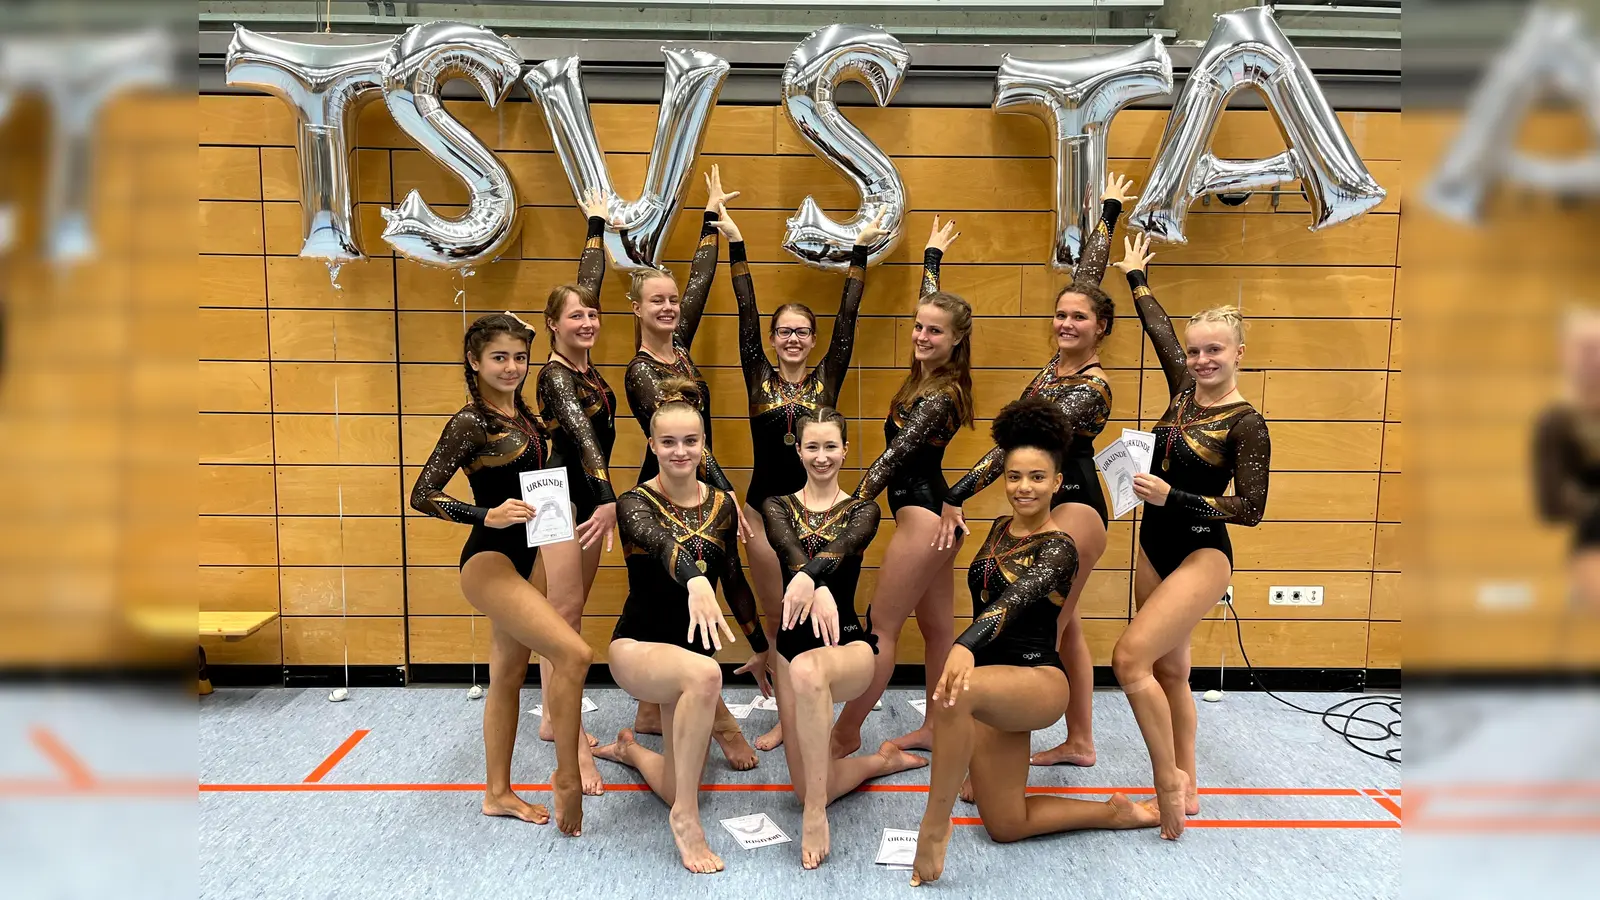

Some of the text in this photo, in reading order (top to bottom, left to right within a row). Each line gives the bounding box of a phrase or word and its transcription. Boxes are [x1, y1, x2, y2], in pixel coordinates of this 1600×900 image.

[225, 5, 1387, 271] TSV STA
[1102, 450, 1127, 471] URKUNDE
[526, 478, 564, 493] URKUNDE
